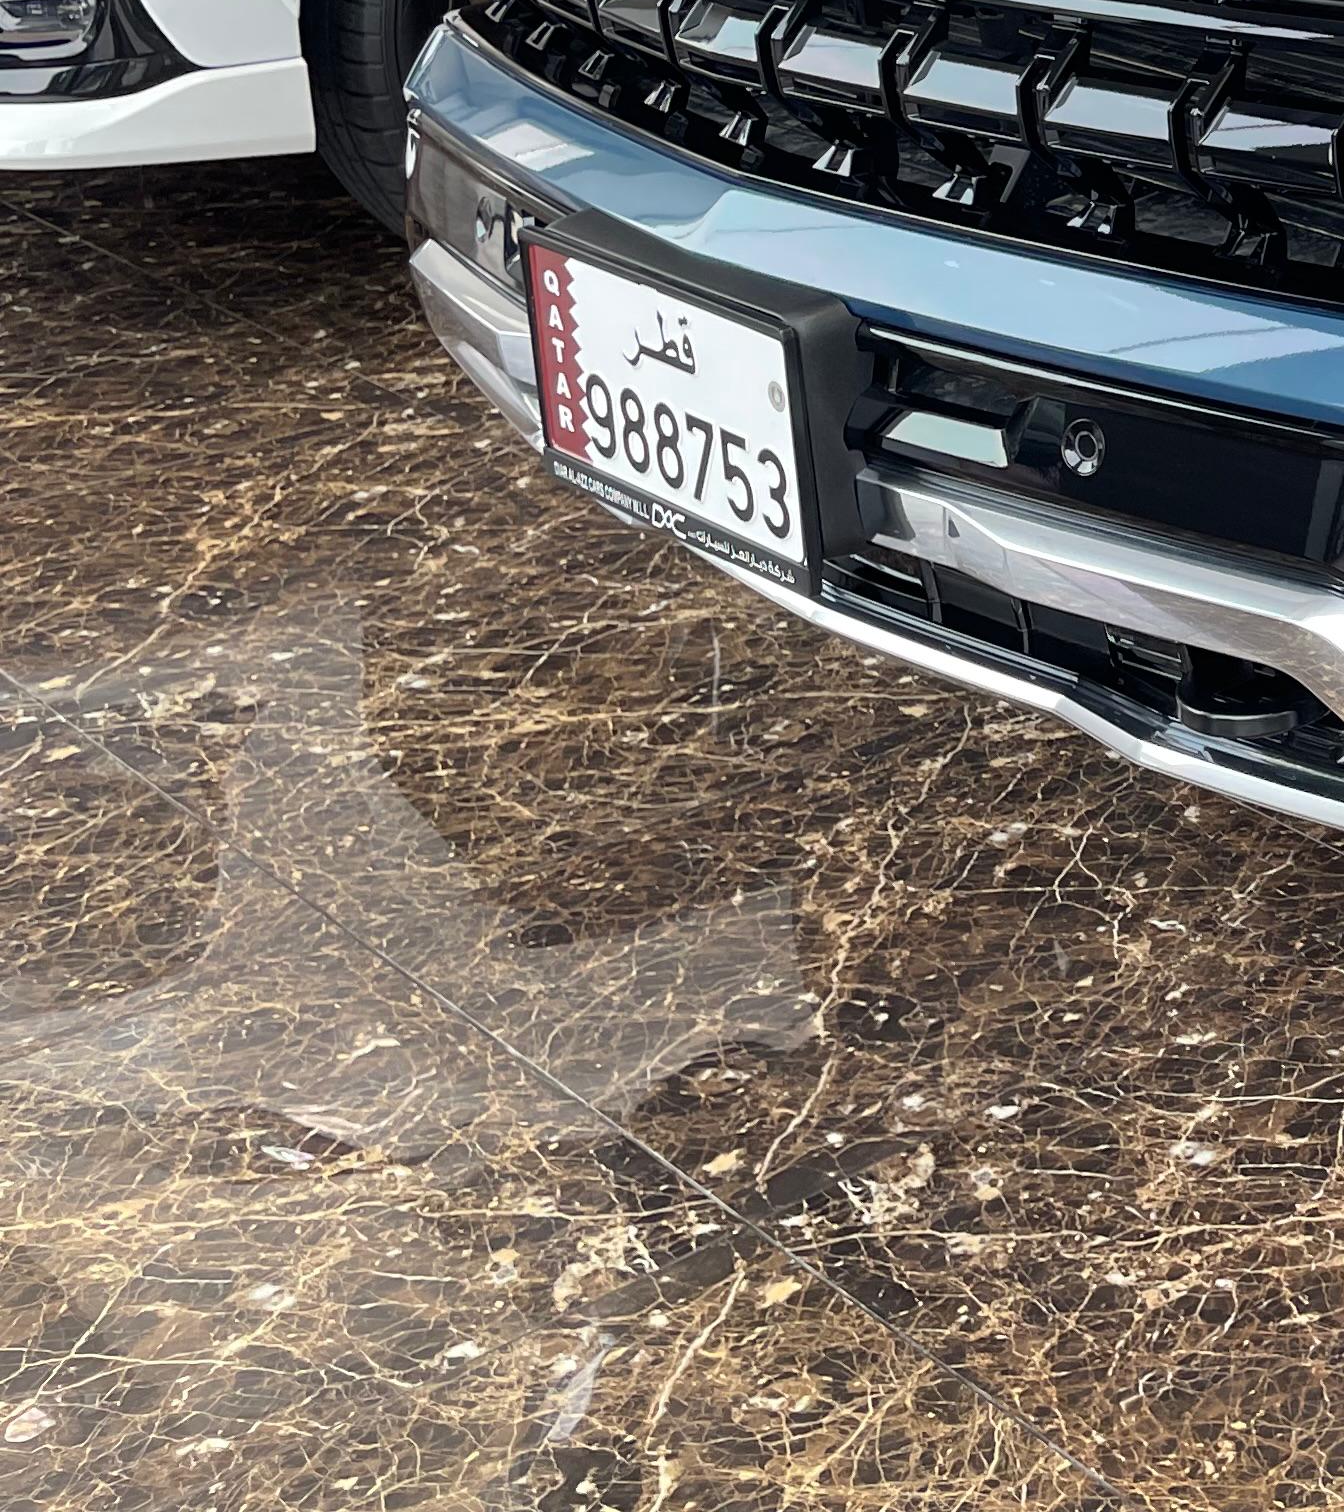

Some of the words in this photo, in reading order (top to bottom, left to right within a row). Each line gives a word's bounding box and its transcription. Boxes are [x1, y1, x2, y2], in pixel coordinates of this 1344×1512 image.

[543, 268, 576, 433] QATAR
[622, 309, 697, 375] قطر
[584, 374, 792, 540] 988753
[767, 560, 796, 584] شركة
